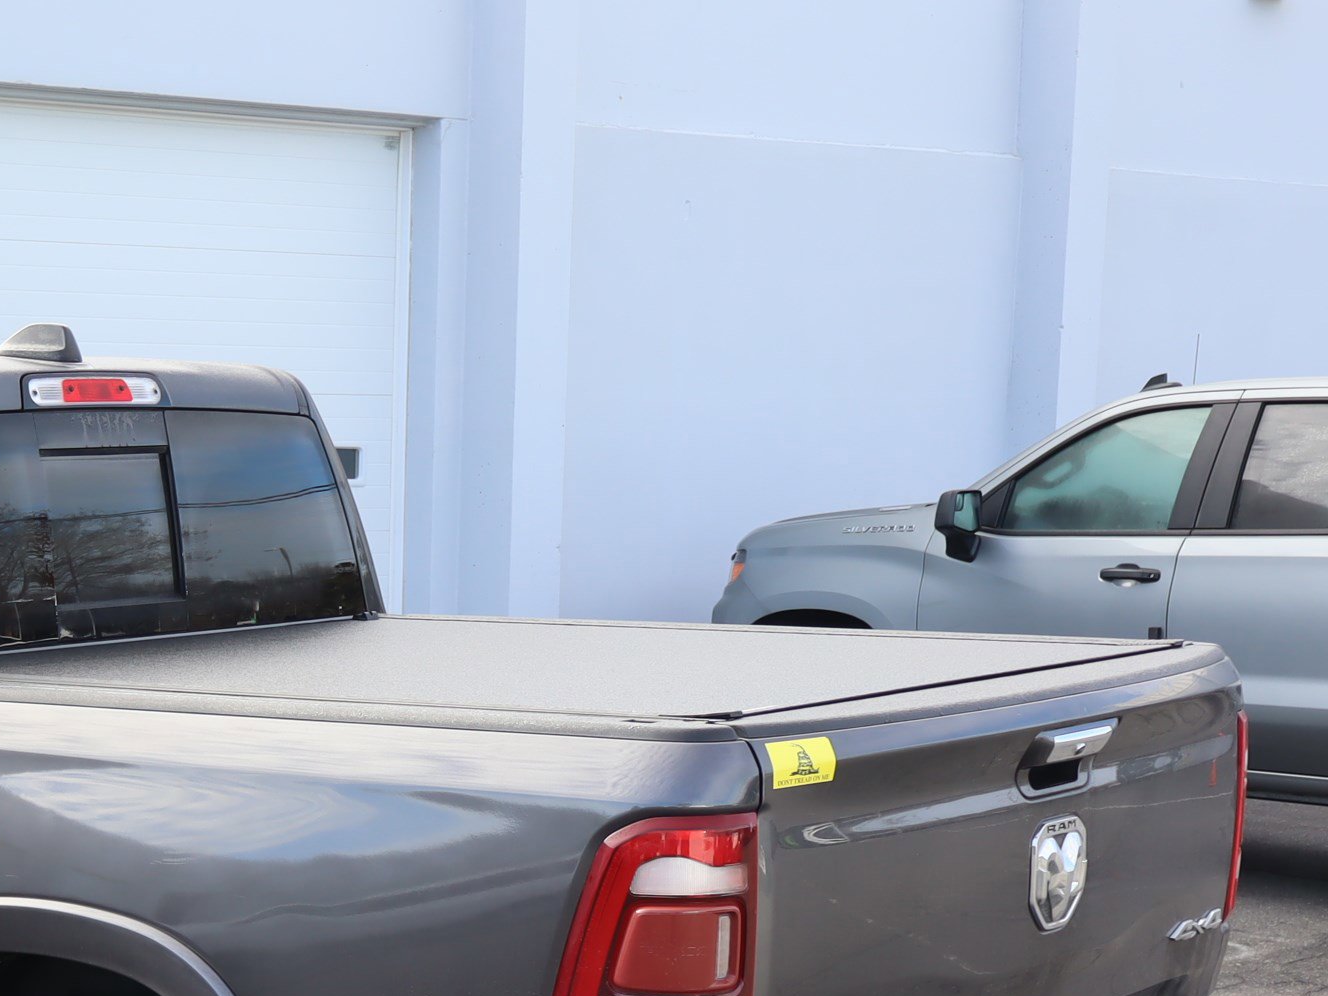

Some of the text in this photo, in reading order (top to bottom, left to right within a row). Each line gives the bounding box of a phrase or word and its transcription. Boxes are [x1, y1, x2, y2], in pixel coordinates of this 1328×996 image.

[842, 525, 916, 534] SILVERADO
[794, 775, 812, 784] TREAD
[1046, 819, 1077, 834] RAM
